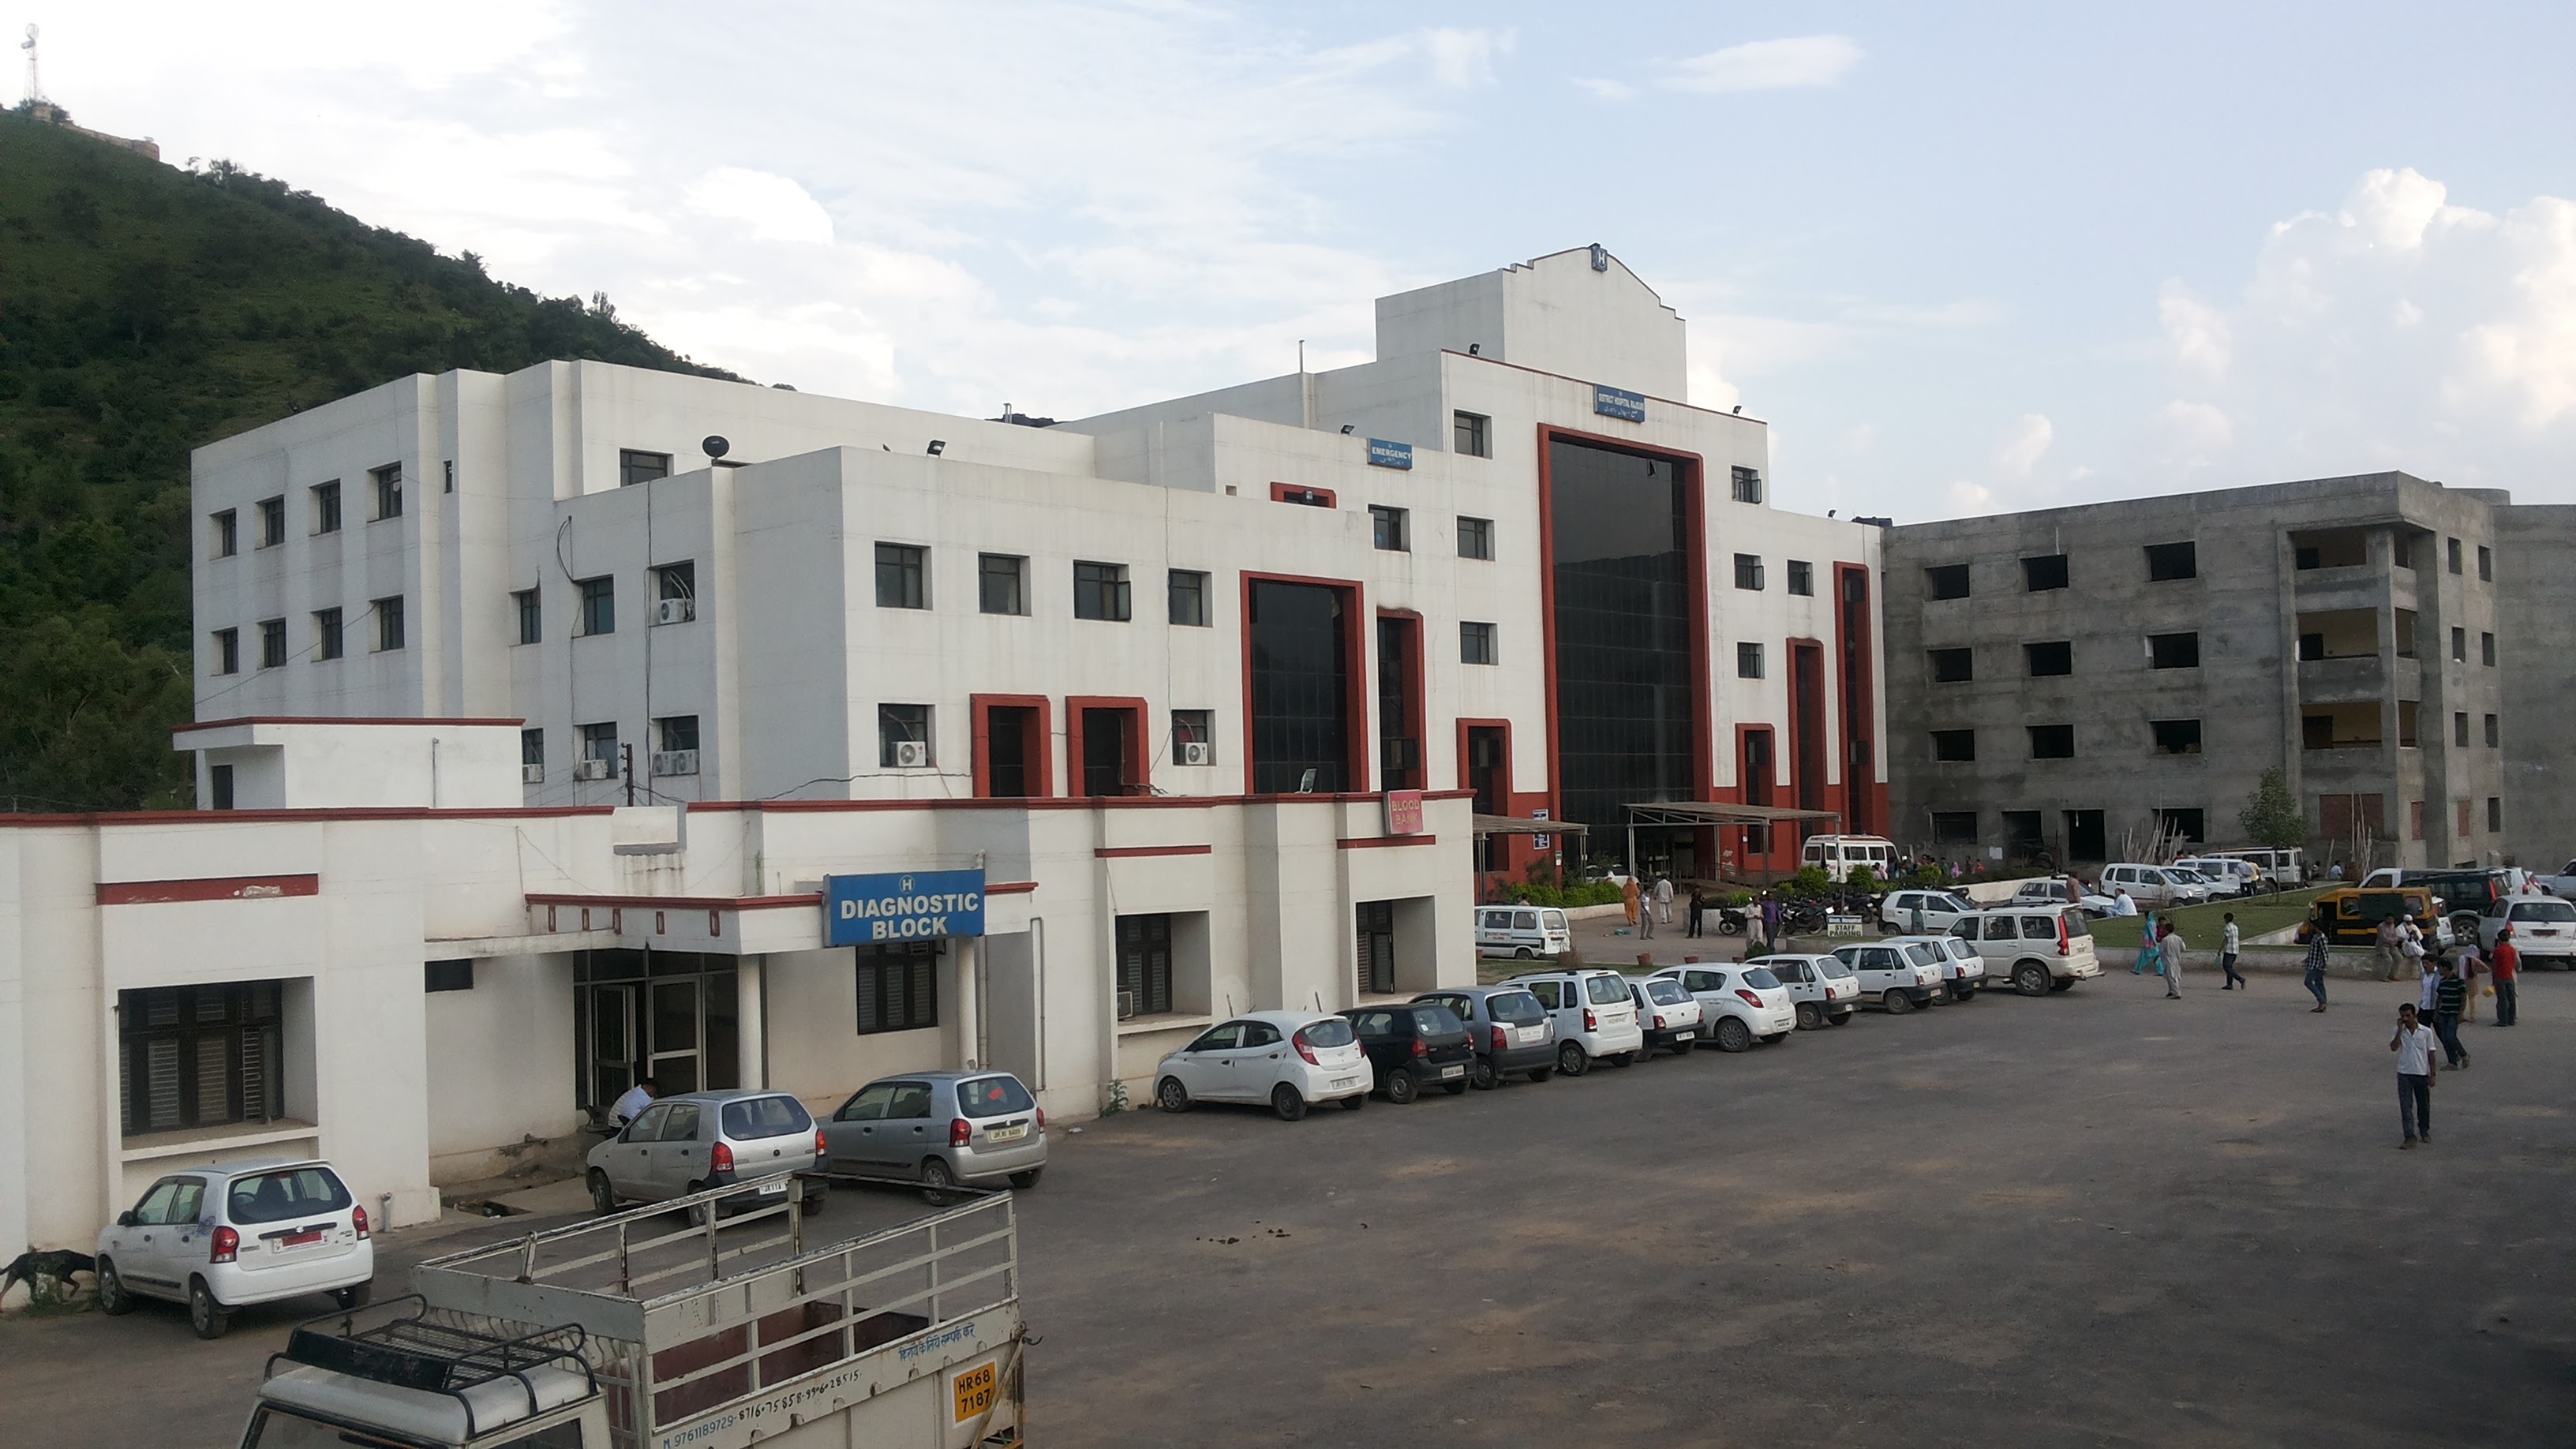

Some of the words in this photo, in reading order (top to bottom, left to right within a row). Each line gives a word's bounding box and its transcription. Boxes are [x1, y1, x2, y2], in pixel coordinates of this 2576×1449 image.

[1598, 252, 1605, 265] H
[1372, 447, 1412, 460] EMERGENCY
[1391, 799, 1420, 811] BLOOD
[1395, 814, 1417, 826] BANK
[902, 879, 912, 891] H
[841, 893, 979, 919] DIAGNOSTIC
[872, 916, 948, 940] BLOCK
[960, 1388, 991, 1413] 7187
